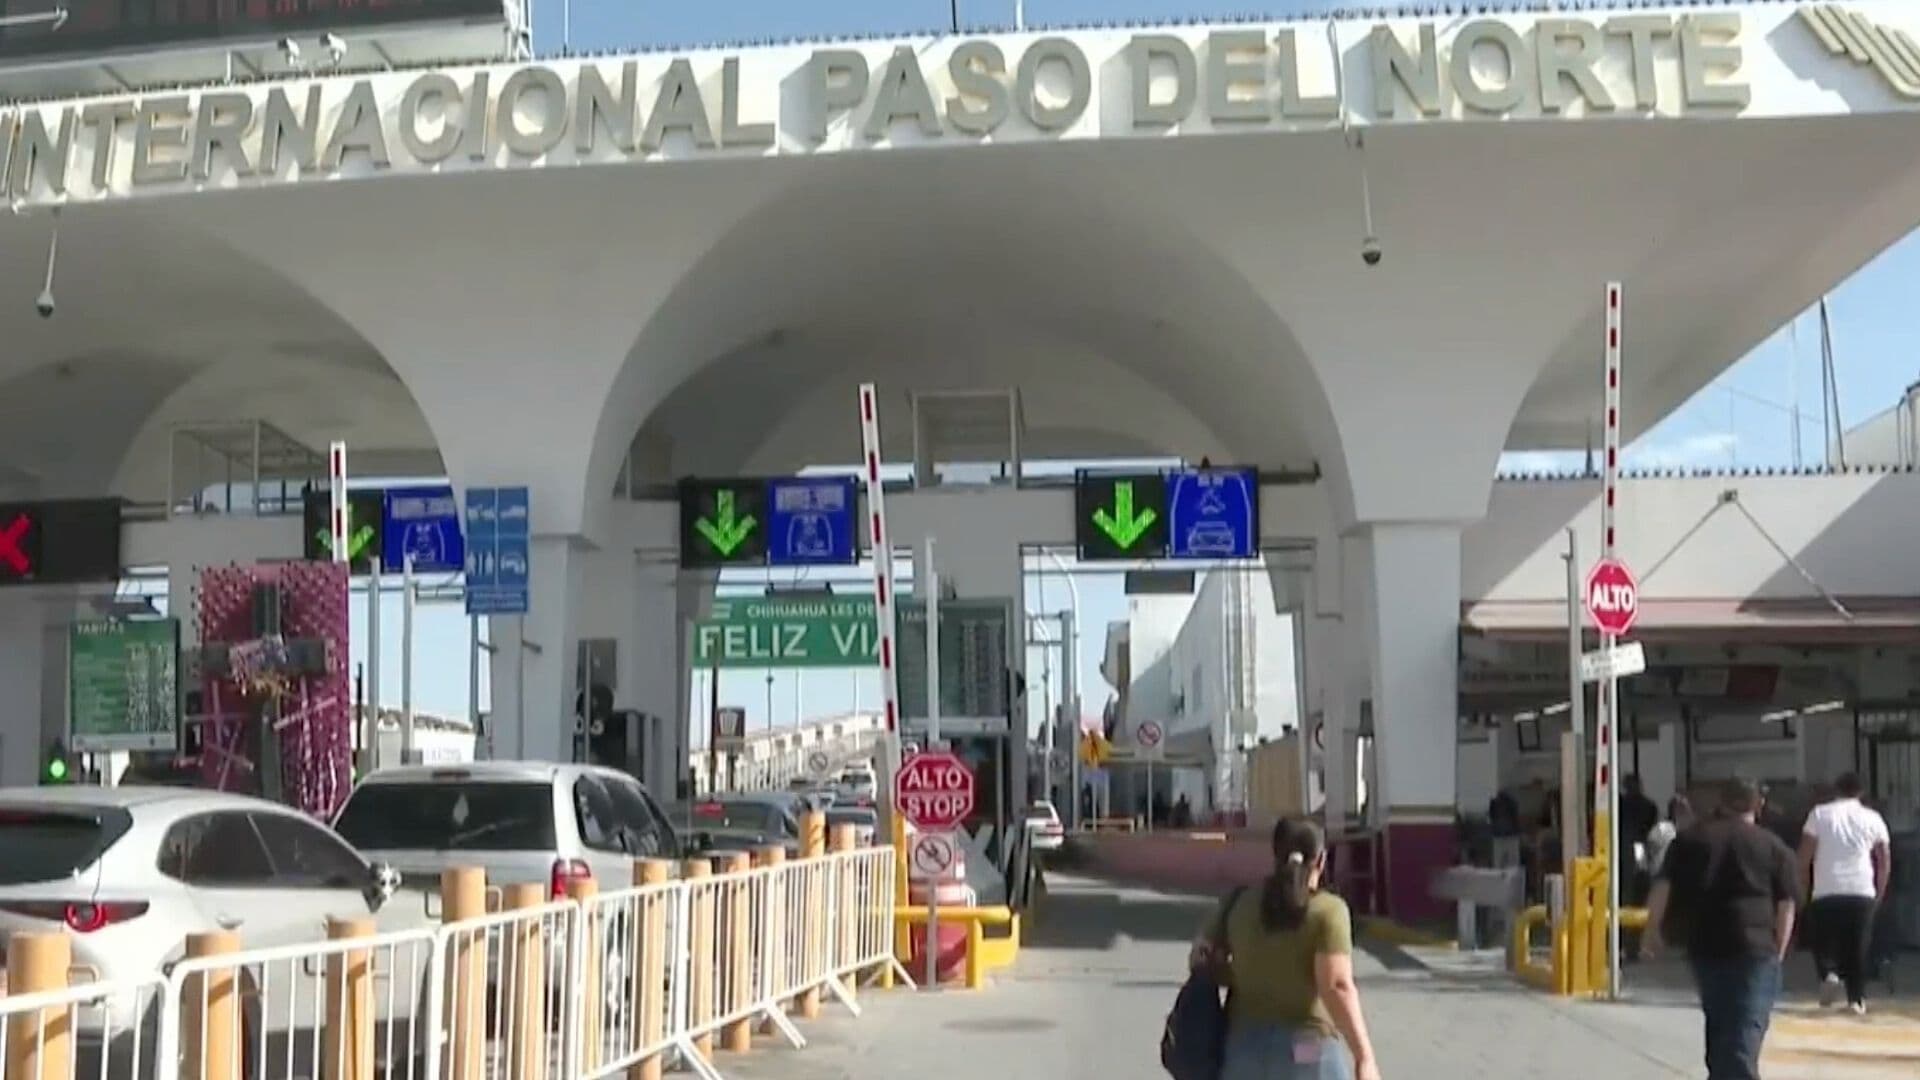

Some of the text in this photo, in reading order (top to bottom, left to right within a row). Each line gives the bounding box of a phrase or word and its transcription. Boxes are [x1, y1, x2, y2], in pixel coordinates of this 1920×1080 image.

[0, 11, 1752, 197] INTERNACIONAL PASO DEL NORTE
[746, 602, 828, 619] CHIHUAHUA
[1592, 583, 1634, 612] ALTO
[700, 624, 808, 658] FELIZ
[907, 766, 962, 789] ALTO
[907, 795, 966, 818] STOP
